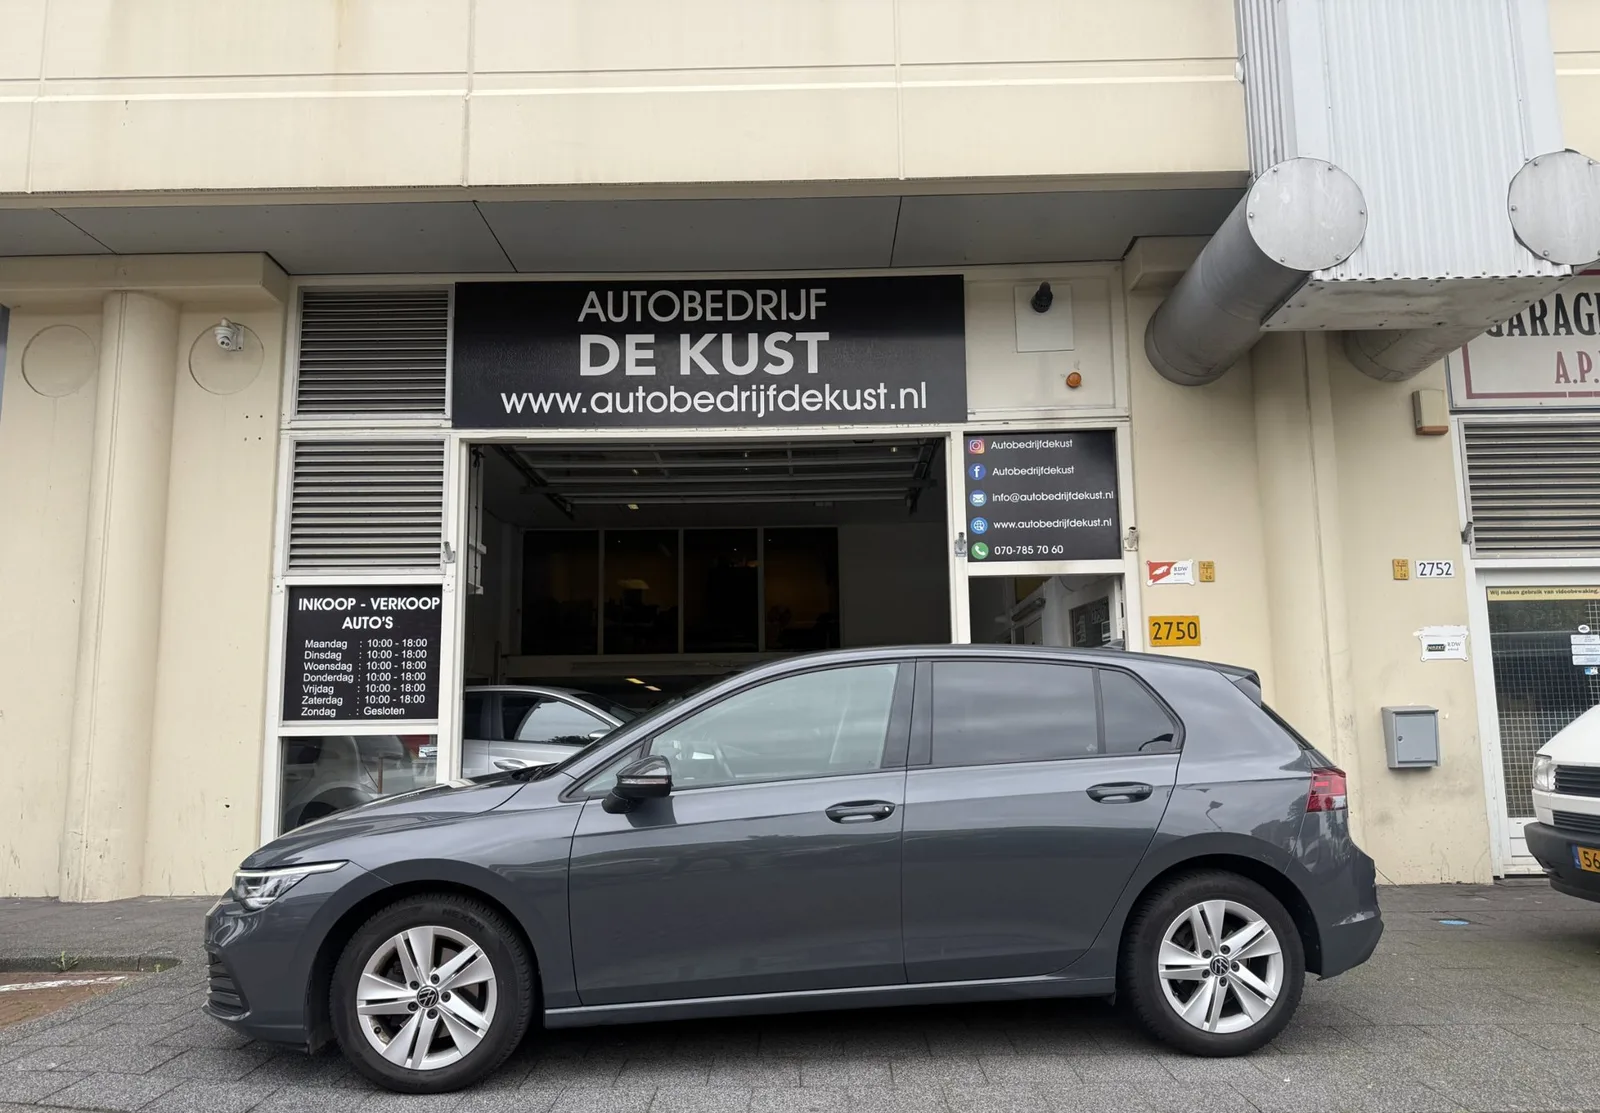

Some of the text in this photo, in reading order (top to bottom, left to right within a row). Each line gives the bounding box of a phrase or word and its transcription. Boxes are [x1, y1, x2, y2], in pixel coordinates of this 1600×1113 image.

[577, 289, 827, 323] AUTOBEDRIJF
[1485, 292, 1600, 338] ARAG
[579, 331, 830, 377] DE KUST
[1555, 350, 1600, 384] A.P.
[500, 381, 927, 418] www.autobedrijfdekust.nl
[990, 439, 1073, 450] Autobedrijfdekust
[992, 465, 1075, 477] Autobedrijfdekust
[992, 490, 1114, 503] info@autobedrijfdekust.nl
[993, 517, 1112, 529] www.autobedrijfdekust.nl
[994, 544, 1064, 556] 070-785 70 60
[1418, 561, 1453, 576] 2752
[298, 597, 357, 611] INKOOP
[370, 596, 441, 611] VERKOOP
[341, 616, 394, 630] AUTO'S
[1152, 621, 1199, 641] 2750
[304, 639, 348, 650] Maandag
[367, 639, 393, 648] 10:00
[402, 639, 428, 648] 18:00
[304, 650, 342, 661] Dinsdag
[366, 650, 393, 659] 10:00
[401, 650, 428, 659] 18:00
[303, 661, 353, 672] Woensdag
[366, 661, 392, 670] 10:00
[401, 661, 427, 670] 18:00
[303, 673, 354, 684] Donderdag
[365, 672, 392, 681] 10:00
[400, 672, 427, 681] 18:00
[302, 684, 335, 696] Vrijdag
[365, 684, 391, 693] 10:00
[400, 684, 426, 693] 18:00
[301, 695, 343, 707] Zaterdag
[364, 695, 391, 704] 10:00
[399, 695, 426, 704] 18:00
[300, 707, 337, 718] Zondag
[363, 706, 405, 716] Gesloten
[1583, 851, 1600, 869] 56
[442, 908, 485, 932] NEXEN
